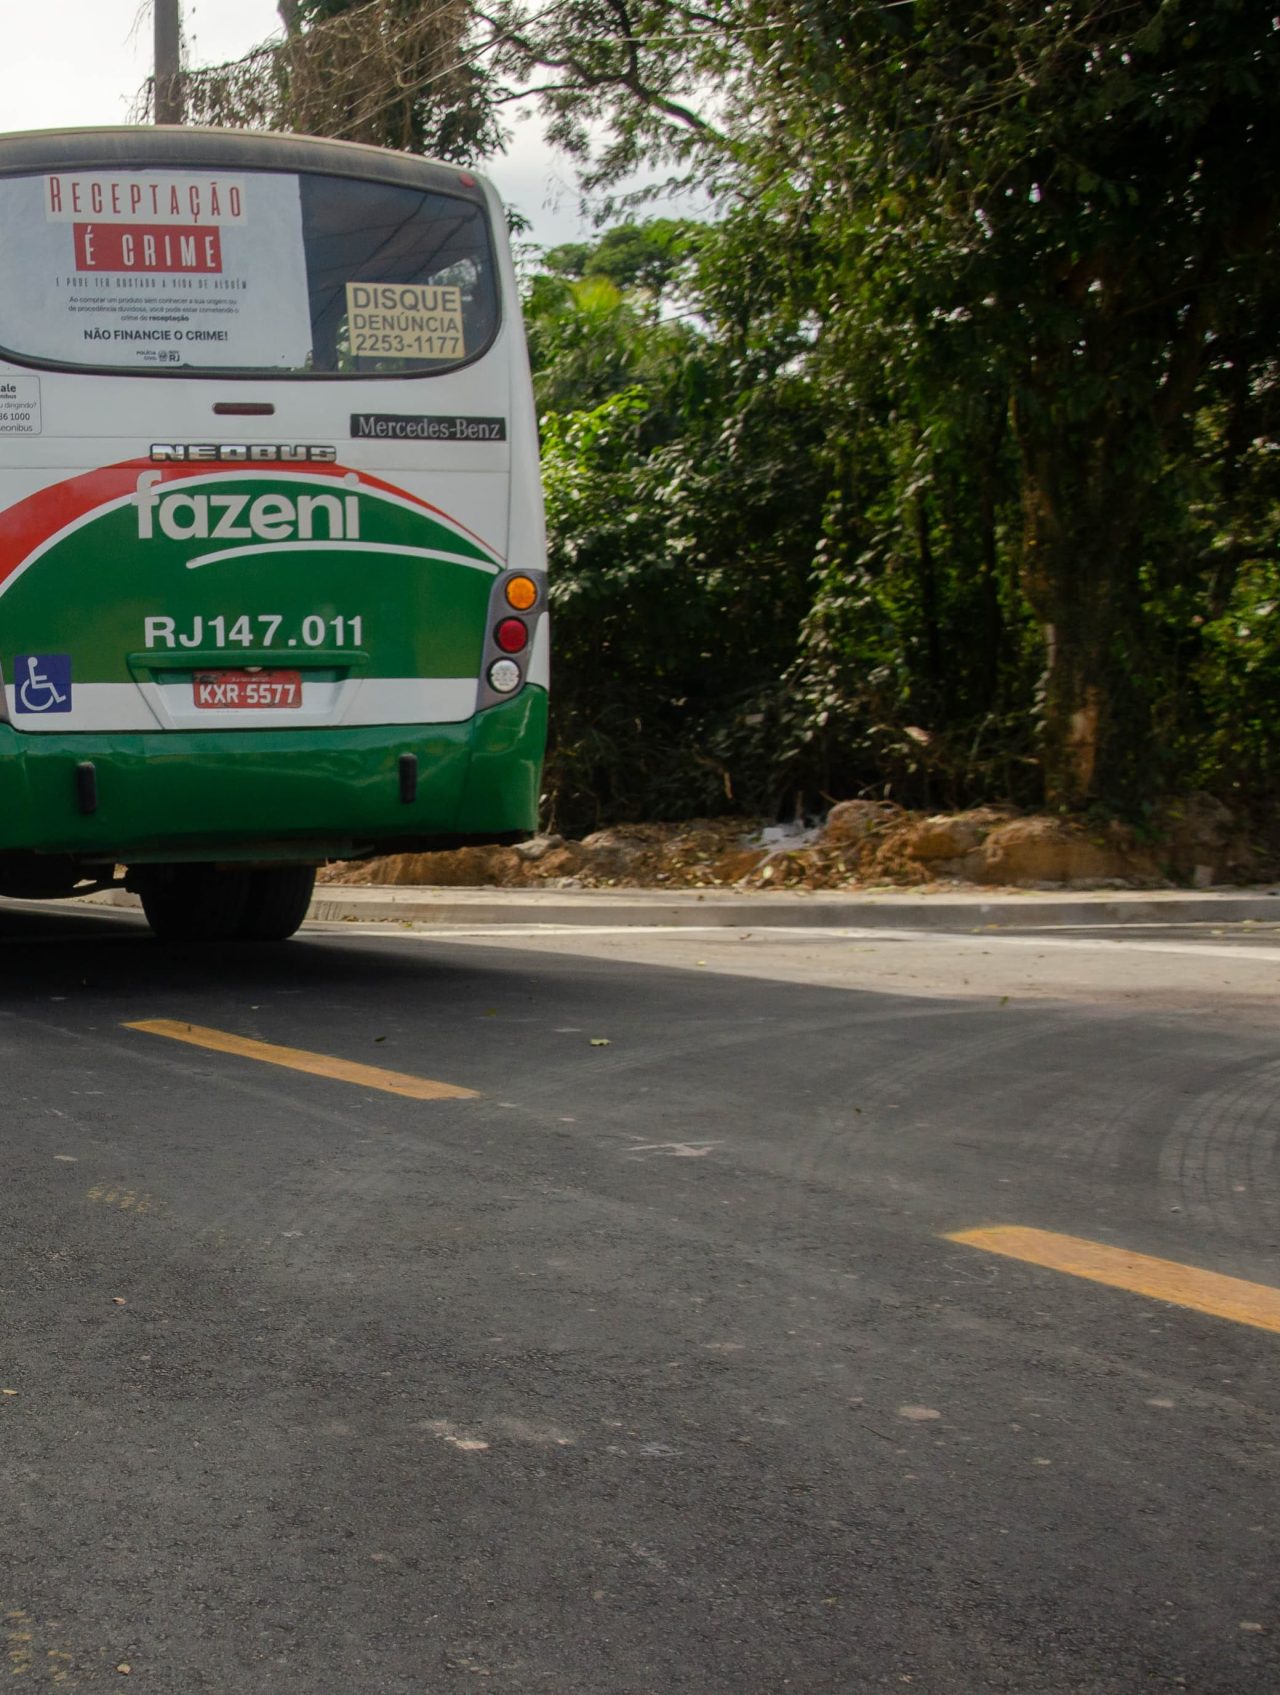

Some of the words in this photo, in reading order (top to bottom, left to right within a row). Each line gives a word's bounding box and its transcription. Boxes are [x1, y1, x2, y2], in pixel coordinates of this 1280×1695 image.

[50, 177, 241, 223] RECEPTAÇÃO
[84, 225, 95, 265] É
[122, 234, 216, 267] CRIME
[353, 287, 458, 312] DISQUE
[353, 312, 460, 333] DENÚNCIA
[84, 327, 111, 340] NÃO
[114, 330, 171, 341] FINANCIE
[174, 330, 183, 341] O
[186, 330, 228, 342] CRIME!
[355, 333, 460, 354] 2253-1177
[10, 412, 31, 421] 1000
[358, 416, 501, 439] Mercedes-Benz
[150, 444, 337, 462] NEOBUS
[131, 470, 360, 541] fazeni
[144, 615, 363, 648] RJ147.011
